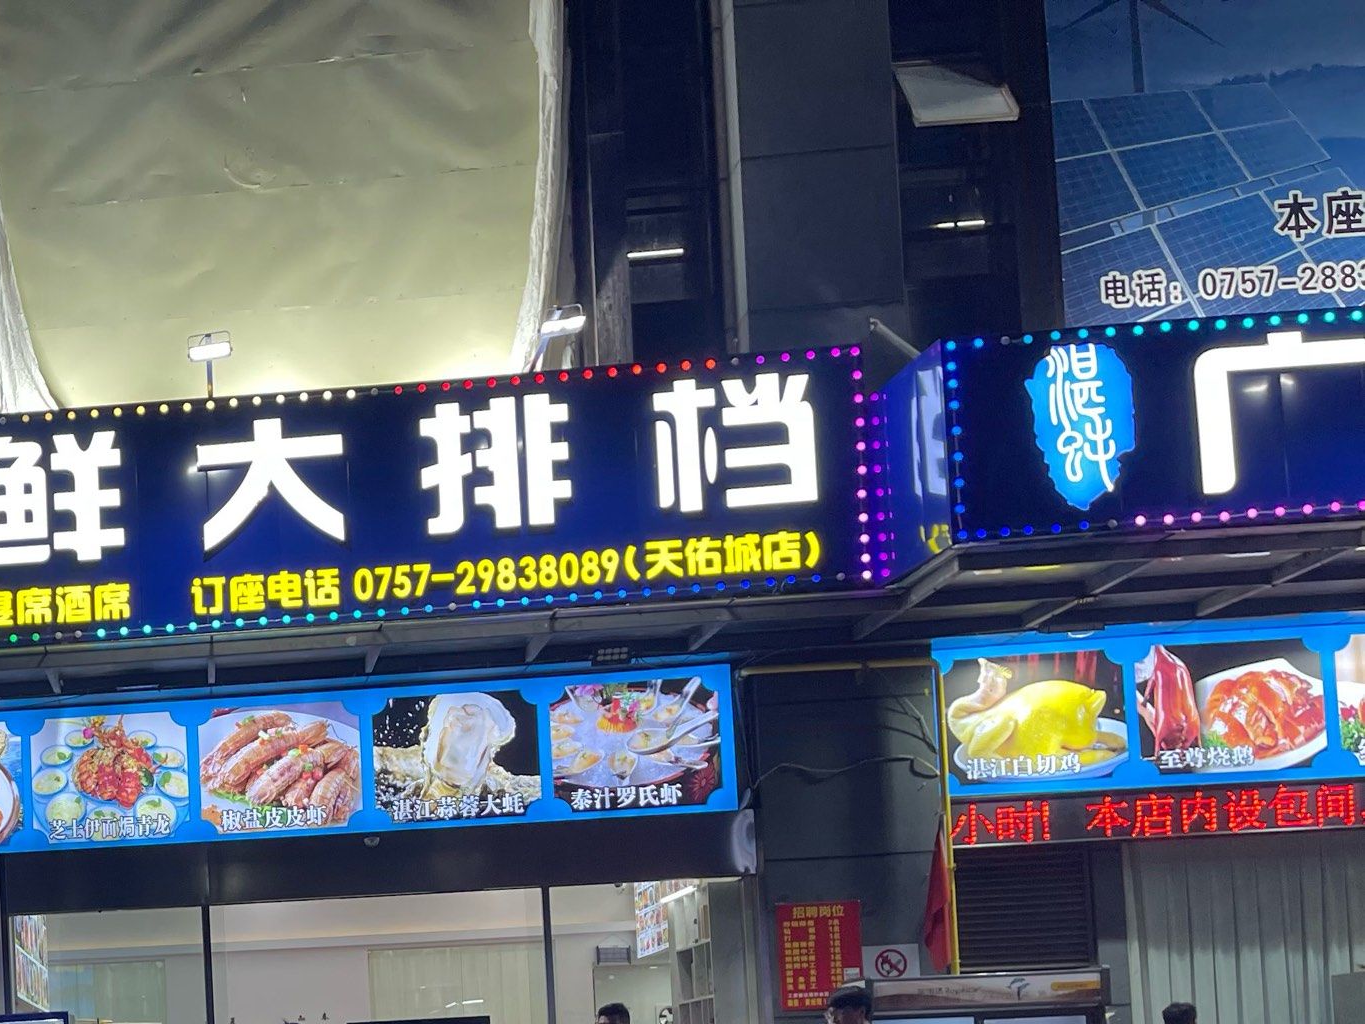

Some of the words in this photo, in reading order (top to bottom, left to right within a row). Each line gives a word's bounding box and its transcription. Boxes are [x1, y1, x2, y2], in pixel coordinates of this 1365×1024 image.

[190, 568, 341, 617] 订座电话
[966, 750, 1081, 780] 湛江白切鸡
[1159, 746, 1255, 771] 至尊烧鹅
[392, 792, 525, 821] 湛江蒜蓉大蚝
[570, 783, 683, 811] 泰汁罗氏虾
[48, 814, 171, 841] 芝士伊面焗青龙
[220, 804, 328, 832] 椒盐皮皮虾
[792, 904, 845, 918] 招聘岗位
